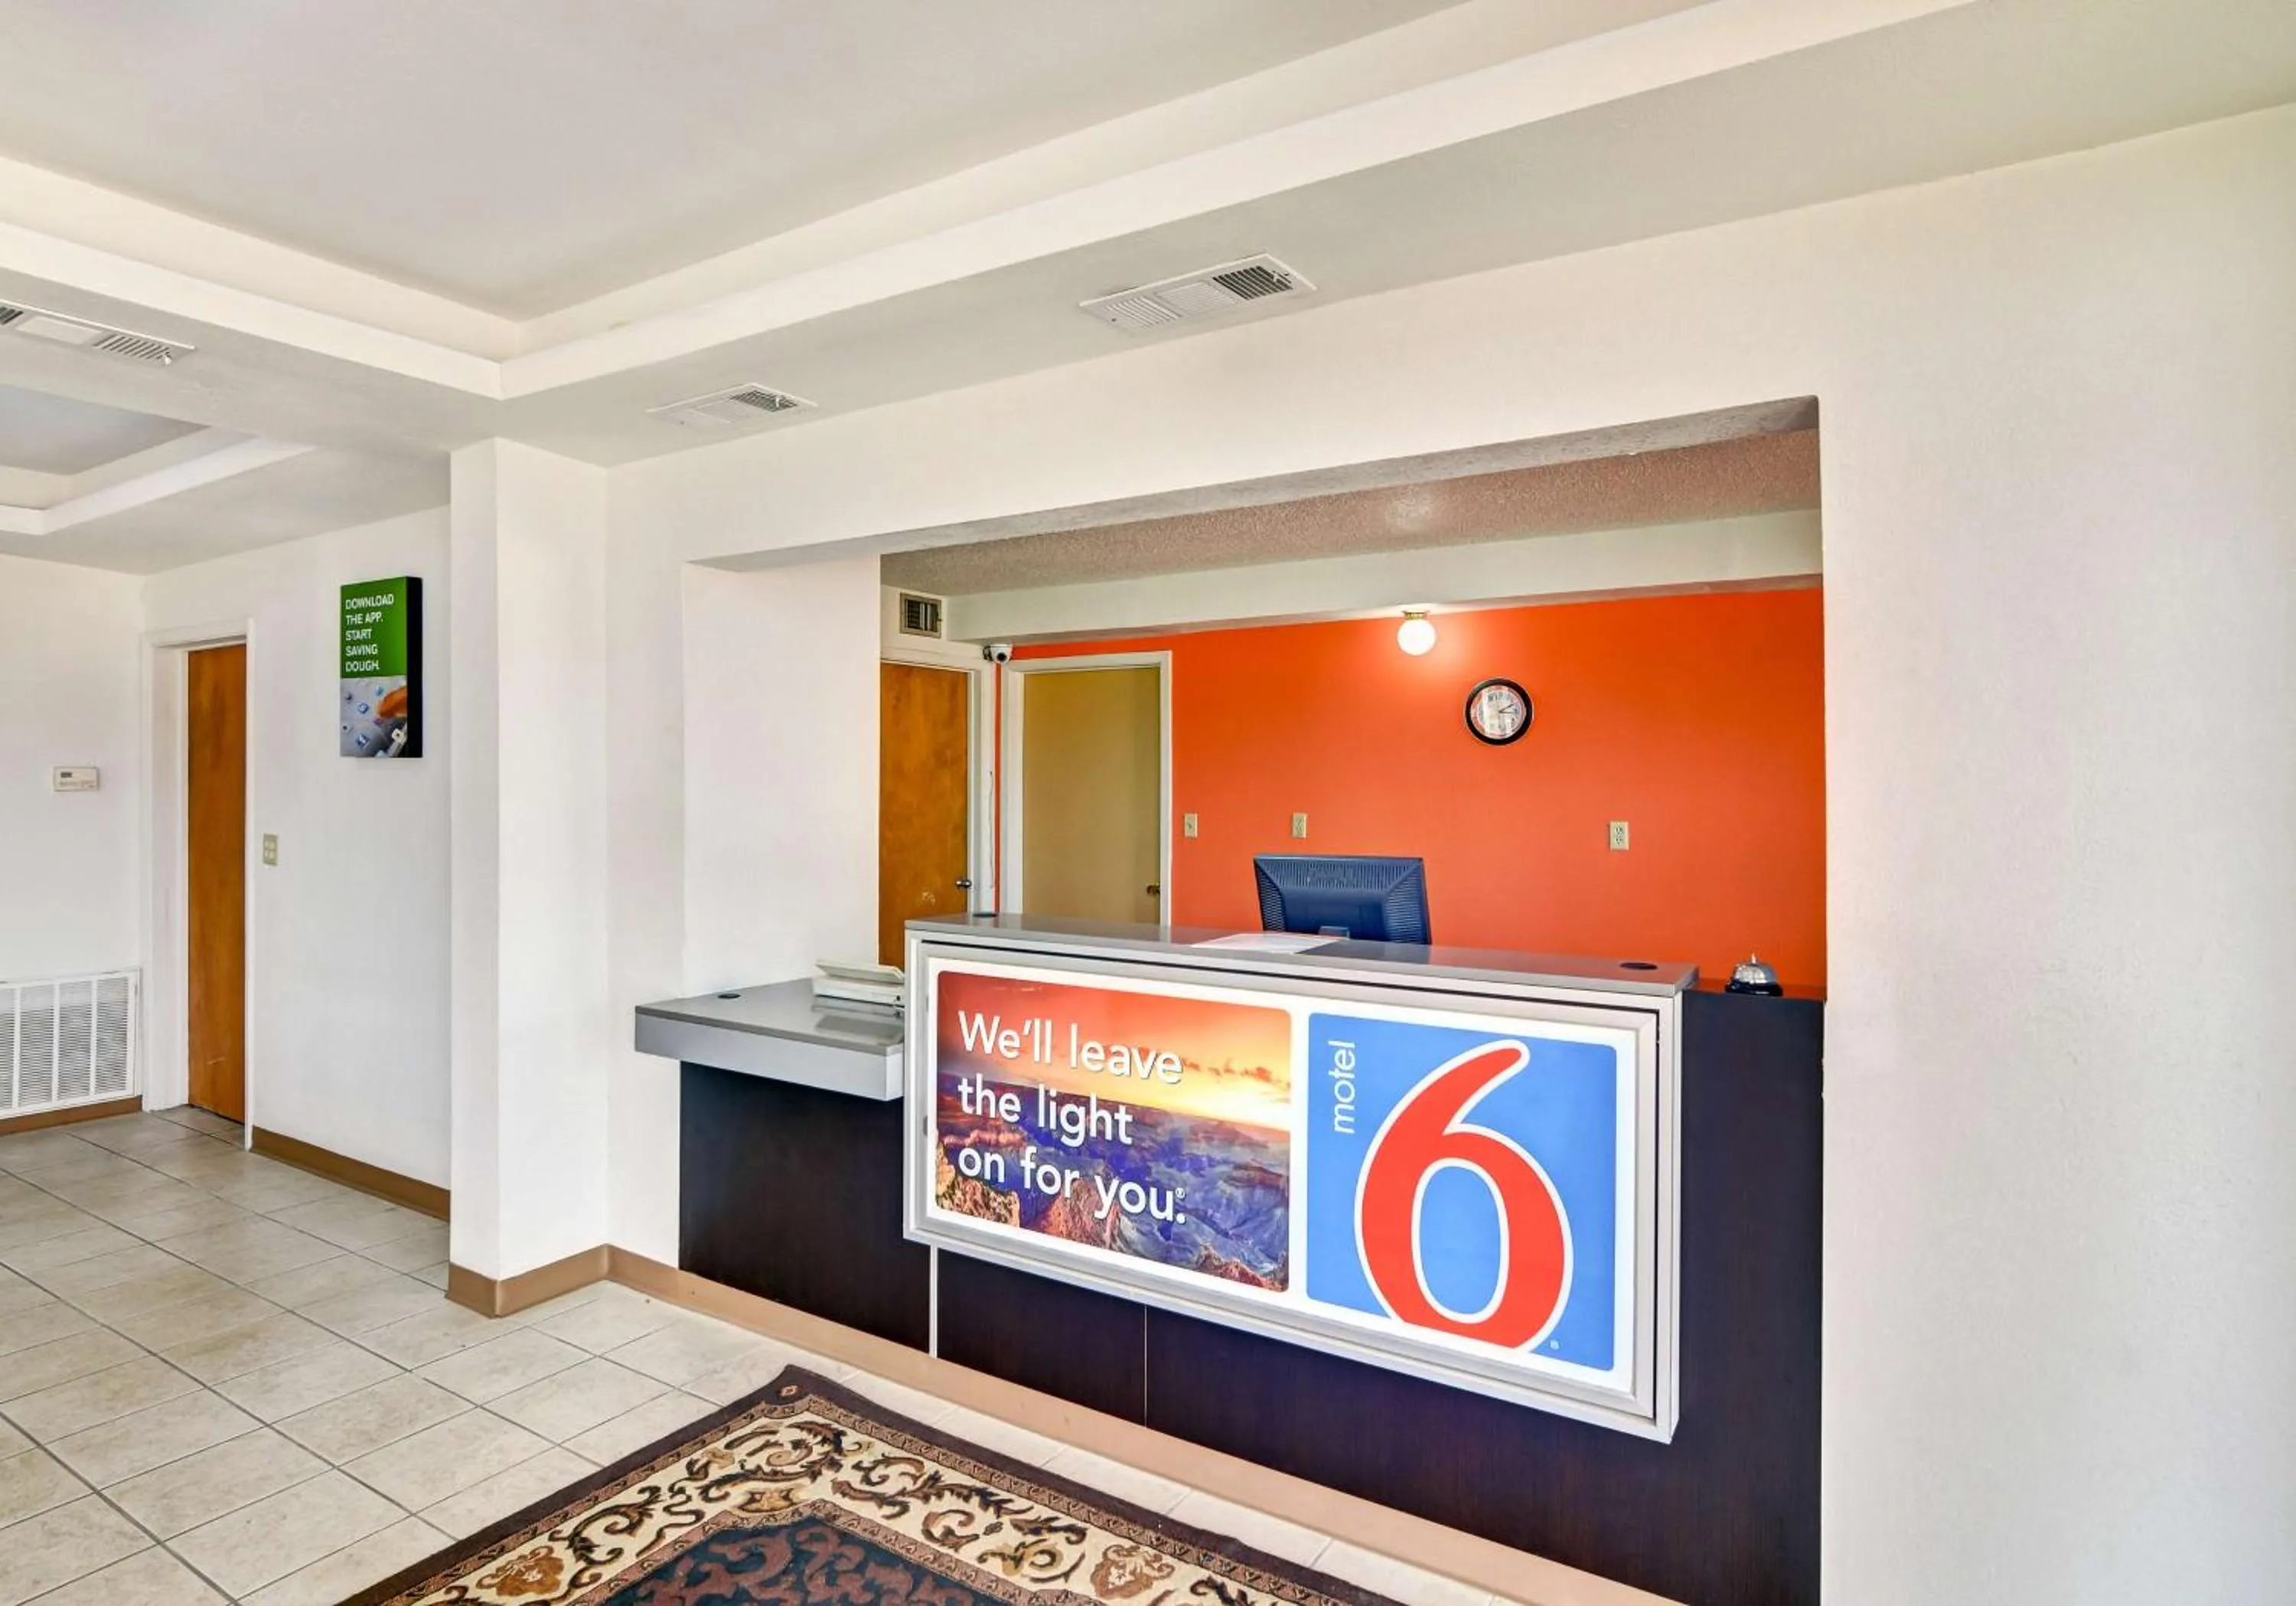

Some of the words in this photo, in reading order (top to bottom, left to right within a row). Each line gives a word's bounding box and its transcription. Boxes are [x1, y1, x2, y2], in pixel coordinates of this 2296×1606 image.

[345, 594, 394, 610] DOWNLOAD
[346, 614, 364, 625] THE
[365, 612, 383, 623] APP.
[345, 629, 372, 641] START
[345, 645, 378, 657] SAVING
[345, 661, 380, 672] DOUGH.
[957, 1010, 1052, 1065] We'll
[1071, 1023, 1184, 1085] leave
[1328, 1040, 1355, 1135] motel
[957, 1073, 1022, 1124] the
[1039, 1083, 1133, 1147] light
[958, 1147, 1006, 1183] on
[1020, 1146, 1080, 1199] for
[1354, 1038, 1574, 1353] 6
